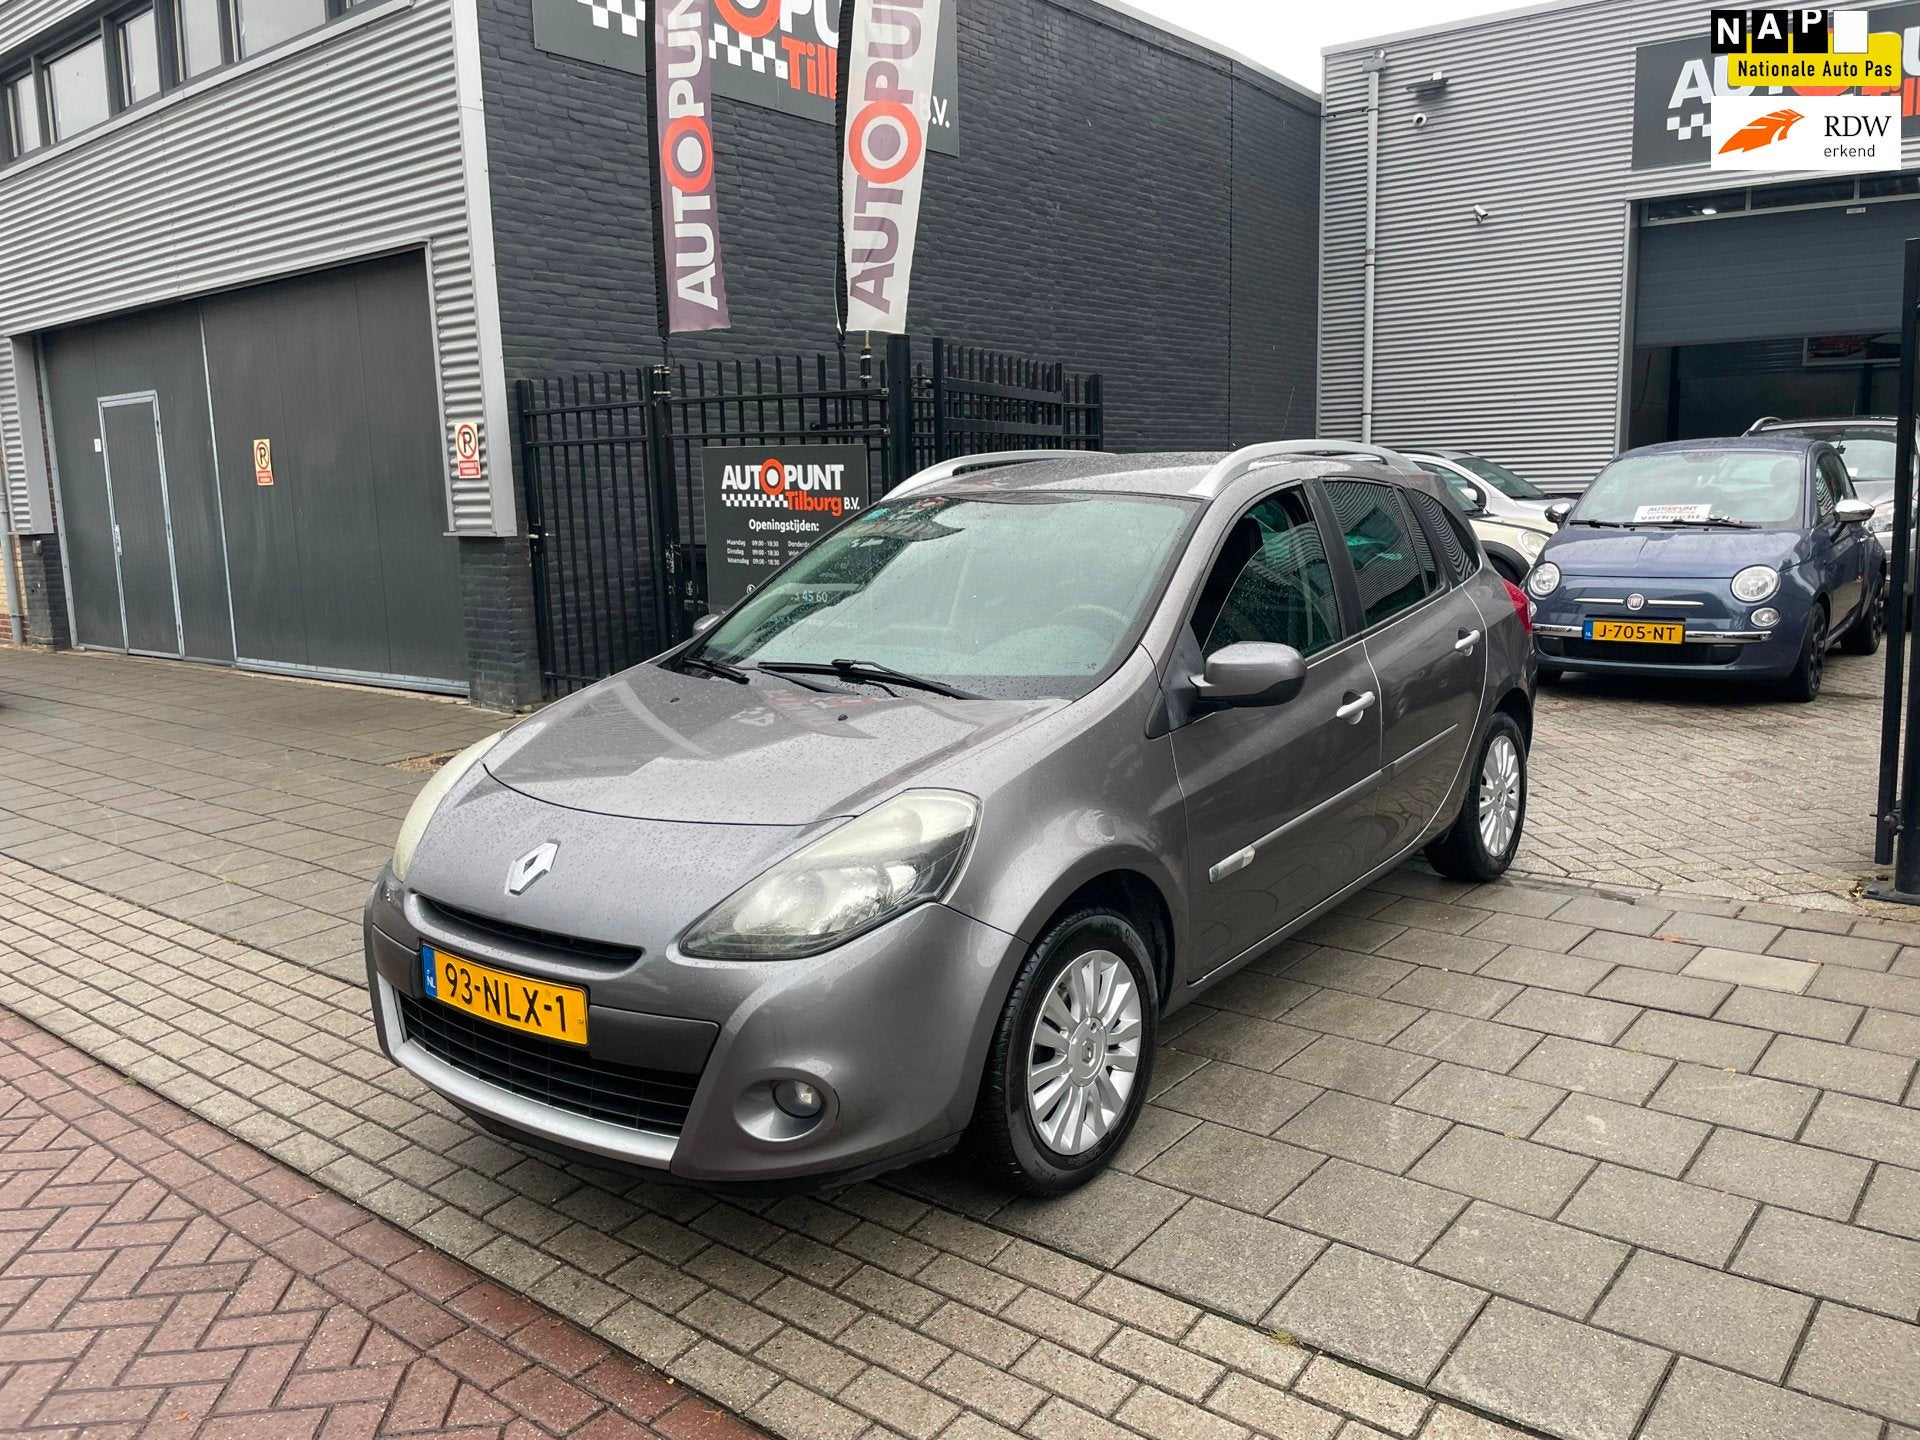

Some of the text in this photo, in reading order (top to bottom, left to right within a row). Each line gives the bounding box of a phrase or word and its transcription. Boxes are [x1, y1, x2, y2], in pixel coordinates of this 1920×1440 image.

[848, 0, 924, 315] AUTOPU
[721, 458, 845, 496] AUTOPUNT
[785, 490, 860, 517] Tilburg B.V.
[749, 518, 820, 533] Openingstijden:
[1599, 624, 1676, 641] J-705-NT
[445, 962, 566, 1033] 93-NLX-1
